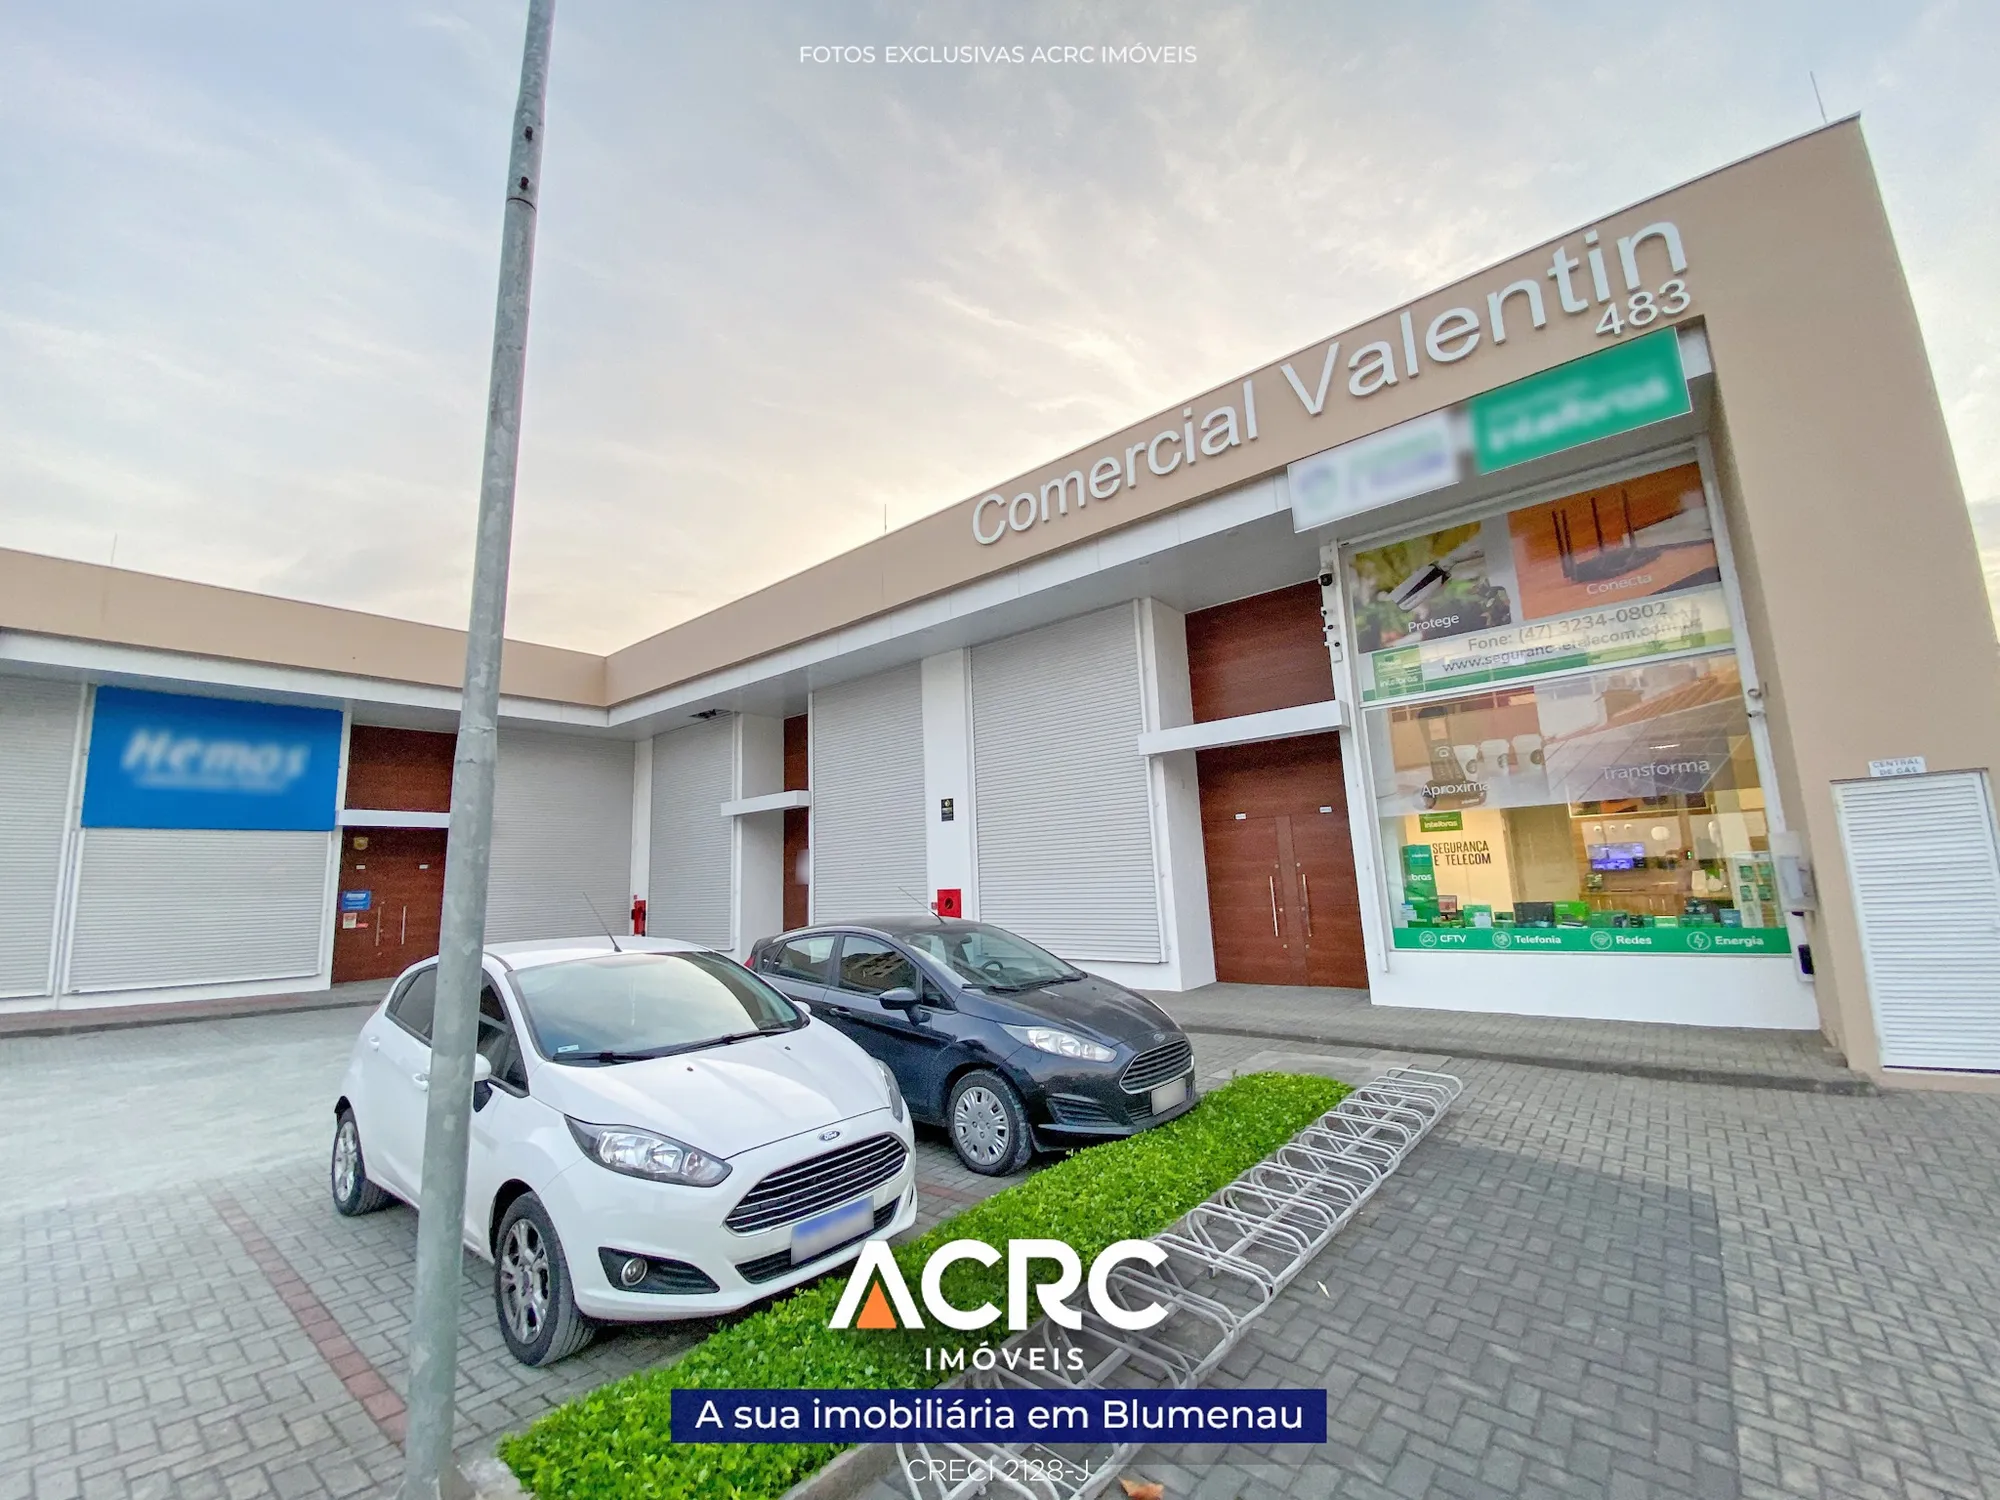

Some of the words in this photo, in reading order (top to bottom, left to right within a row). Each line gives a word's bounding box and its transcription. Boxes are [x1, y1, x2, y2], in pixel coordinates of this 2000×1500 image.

[1594, 278, 1692, 337] 483
[971, 380, 1258, 546] Comercial
[1281, 220, 1689, 417] Valentin
[1586, 574, 1653, 596] Conecta
[1407, 613, 1460, 633] Protege
[1468, 634, 1512, 651] Fone:
[1519, 623, 1551, 644] (47)
[1558, 602, 1667, 633] 3234-0802
[1600, 760, 1710, 780] Transforma
[1432, 840, 1490, 855] SEGURANÇA
[1433, 854, 1441, 867] E
[1445, 852, 1492, 867] TELECOM
[1439, 934, 1468, 944] CFTV
[1514, 935, 1562, 945] Telefonia
[1615, 935, 1653, 945] Redes
[1714, 935, 1765, 946] Energia
